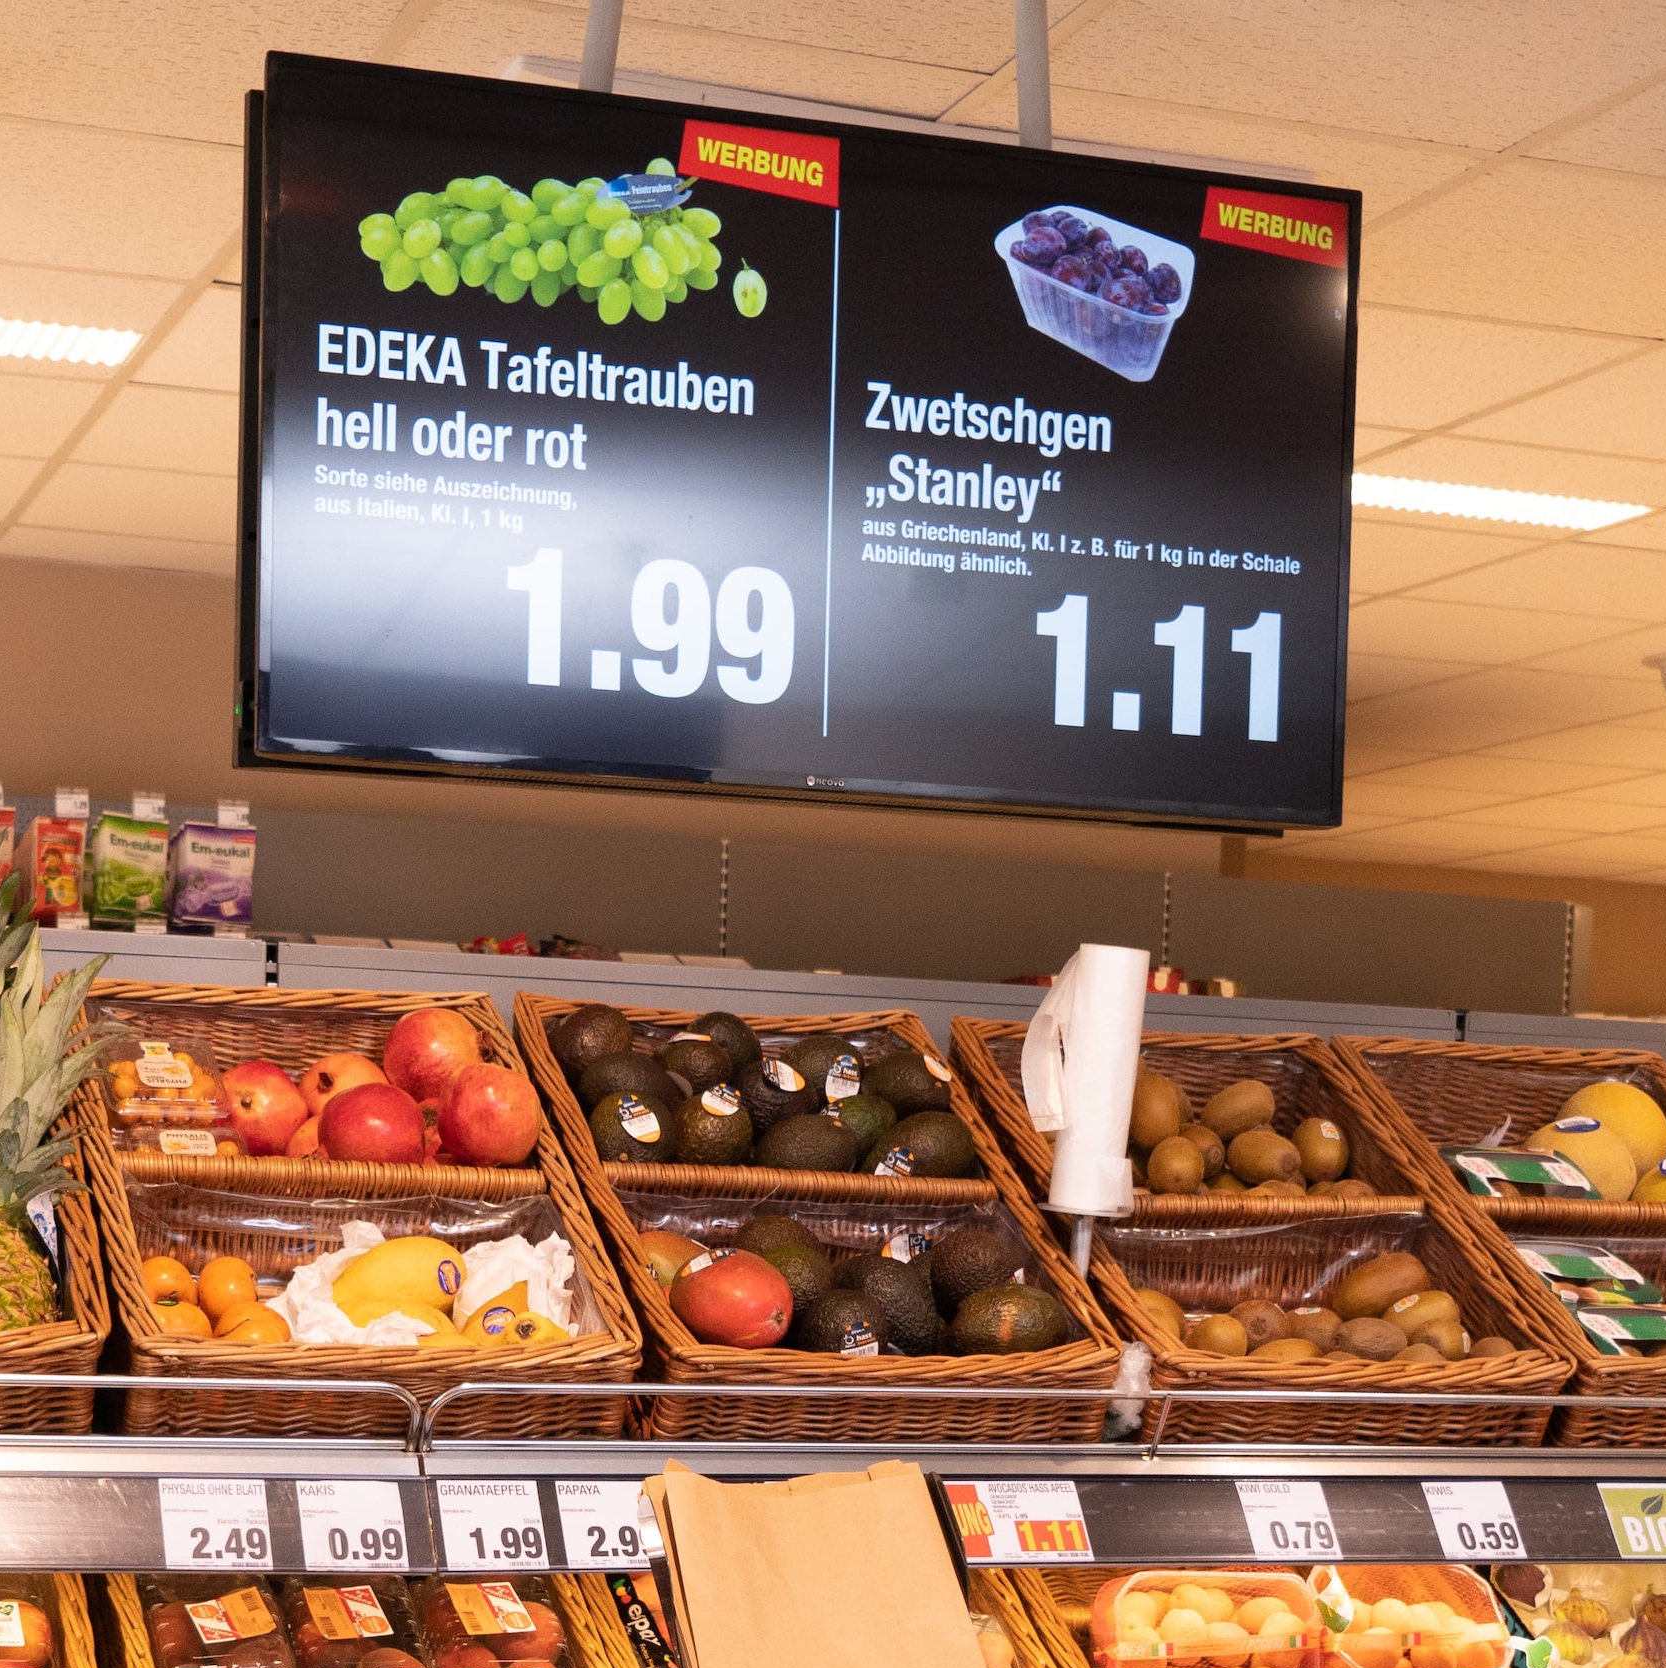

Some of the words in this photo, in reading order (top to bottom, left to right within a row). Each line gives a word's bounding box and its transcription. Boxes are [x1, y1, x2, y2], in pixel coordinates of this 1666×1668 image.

[697, 136, 824, 187] WERBUNG
[631, 183, 673, 195] Feintrauben
[1218, 202, 1333, 250] WERBUNG
[318, 323, 467, 387] EDEKA
[479, 340, 755, 416] Tafeltrauben
[316, 396, 397, 452] hell
[412, 411, 512, 462] oder
[526, 423, 587, 470] rot
[865, 381, 1113, 458] Zwetschgen
[314, 464, 368, 488] Sorte
[374, 471, 427, 494] siehe
[433, 476, 577, 511] Auszeichnung,
[314, 497, 351, 514] aus
[357, 497, 425, 525] Italien,
[433, 503, 455, 524] Kl.
[481, 509, 490, 527] 1
[499, 510, 523, 534] kg
[862, 520, 896, 537] aus
[901, 520, 1026, 552] Griechenland,
[1033, 532, 1054, 552] Kl.
[1071, 539, 1085, 555] z.
[1091, 538, 1109, 557] B.
[1114, 540, 1140, 560] für
[1145, 543, 1153, 561] 1
[1161, 544, 1182, 567] kg
[1188, 547, 1204, 566] in
[1209, 549, 1237, 569] der
[1242, 552, 1300, 575] Schale
[862, 543, 955, 573] Abbildung
[960, 552, 1032, 576] ähnlich.
[505, 547, 796, 705] 1.99
[1035, 592, 1283, 743] 1.11
[110, 833, 164, 853] Em-eukal
[191, 841, 251, 859] Em-eukal
[162, 1483, 206, 1496] PHYSALIS
[208, 1484, 233, 1496] OHNE
[236, 1484, 264, 1496] BLATT
[300, 1484, 336, 1496] KAKIS
[440, 1484, 529, 1496] GRANATAEPFEL
[558, 1484, 601, 1496] PAPAYA
[988, 1483, 1028, 1494] AVOCADOS
[1029, 1483, 1050, 1493] HASS
[1051, 1483, 1075, 1493] APEEL
[1237, 1483, 1261, 1494] KIWI
[1263, 1483, 1291, 1494] GOLD
[1425, 1486, 1453, 1496] KIWIS
[190, 1527, 268, 1560] 2.49
[328, 1528, 404, 1561] 0.99
[469, 1527, 543, 1560] 1.99
[587, 1526, 649, 1558] 2.9
[1018, 1520, 1085, 1551] 1.11
[1269, 1521, 1334, 1550] 0.79
[1457, 1522, 1520, 1551] 0.59
